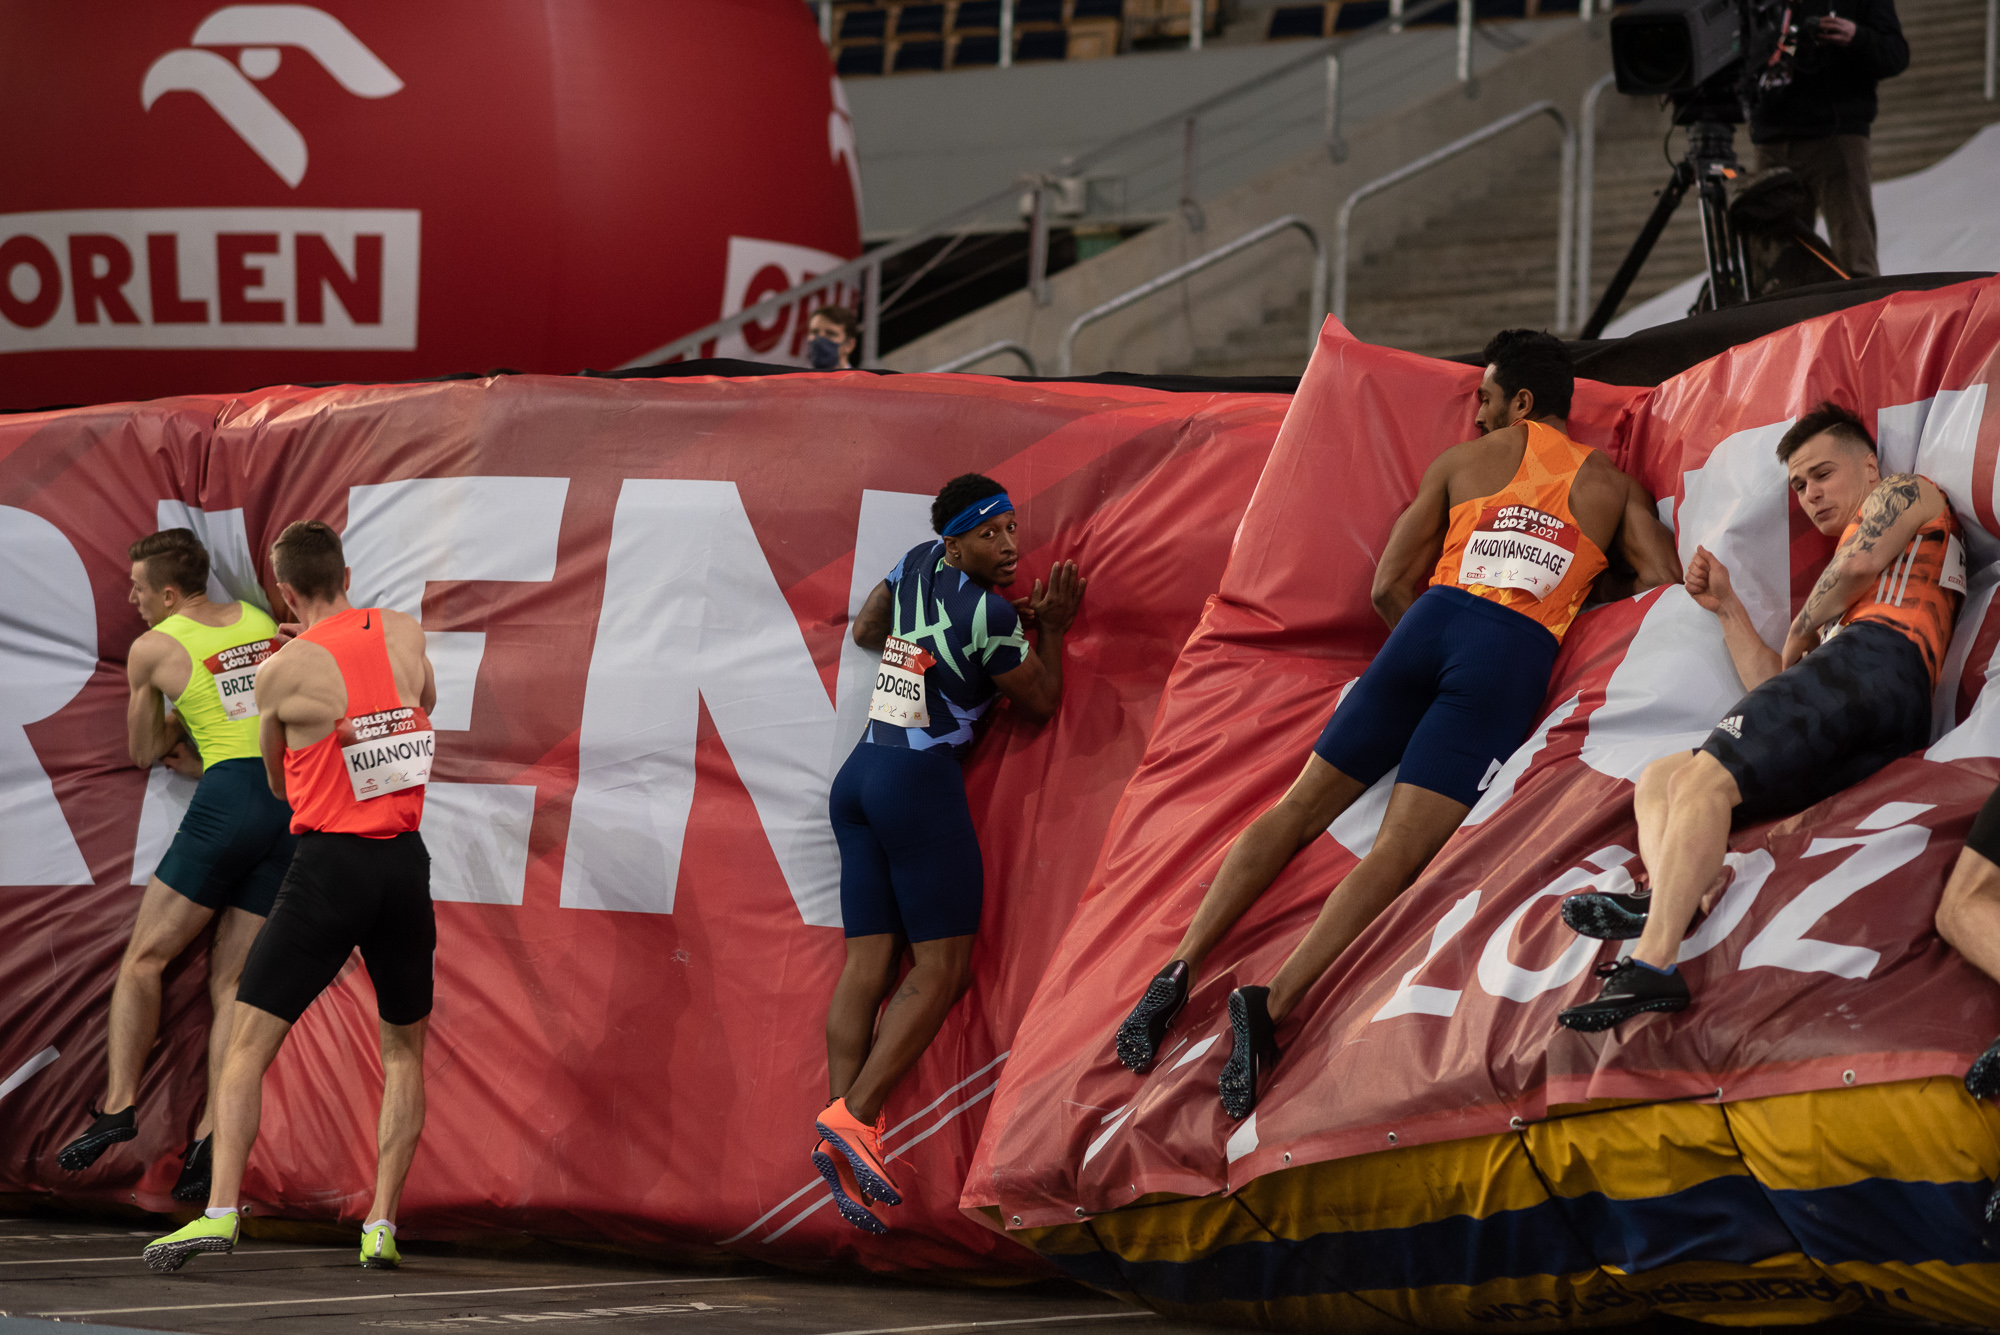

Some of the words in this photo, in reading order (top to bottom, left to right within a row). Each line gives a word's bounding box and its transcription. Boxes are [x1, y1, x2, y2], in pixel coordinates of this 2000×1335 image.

[0, 232, 384, 330] ORLEN
[1493, 517, 1528, 530] ŁÓDŹ
[1530, 523, 1559, 541] 2021
[1497, 506, 1539, 522] ORLEN
[1539, 514, 1565, 530] CUP
[1470, 538, 1566, 577] MUDIYANSELAGE
[218, 644, 253, 662] ORLEN
[252, 640, 271, 652] CUP
[885, 637, 909, 653] ORLEN
[907, 644, 923, 656] CUP
[222, 654, 252, 670] ŁÓDŹ
[221, 673, 256, 697] BRZE
[875, 672, 921, 701] ODGERS
[351, 713, 392, 728] ORLEN
[391, 708, 414, 720] CUP
[355, 723, 390, 740] ŁÓDŹ
[390, 719, 417, 733] 2021
[350, 735, 434, 773] KIJANOVIĆ
